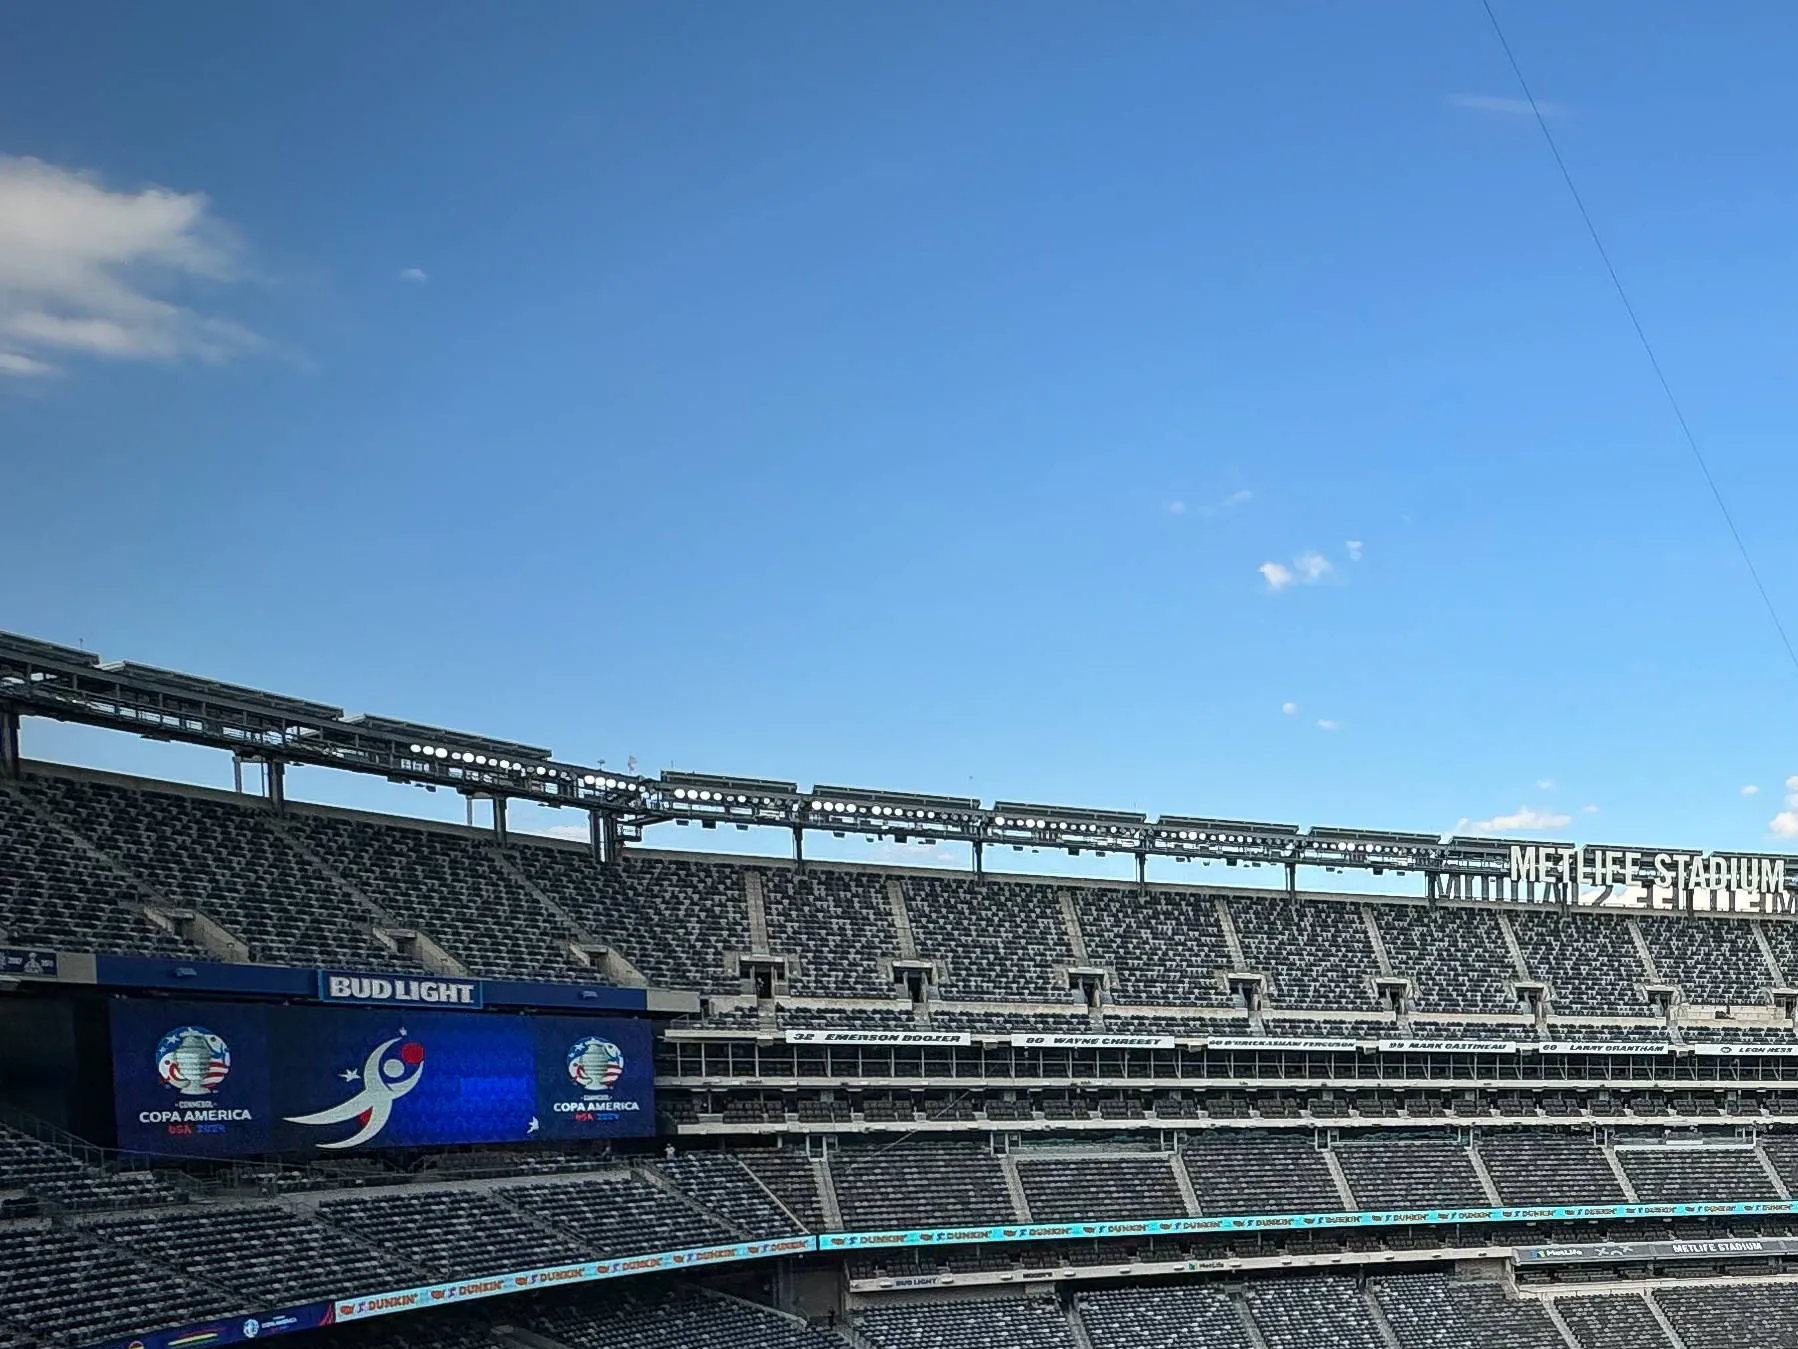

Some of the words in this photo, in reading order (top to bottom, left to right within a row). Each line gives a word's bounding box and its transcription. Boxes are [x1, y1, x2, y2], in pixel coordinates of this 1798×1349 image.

[1510, 845, 1642, 887] METLIFE
[1654, 853, 1785, 894] STADIUM
[329, 976, 392, 999] BUD
[395, 980, 475, 1003] LIGHT
[553, 1102, 586, 1112] COPA
[587, 1101, 640, 1111] AMERICA
[139, 1111, 181, 1123] COPA
[184, 1109, 252, 1122] AMERICA
[1545, 1248, 1583, 1258] MetLife
[1672, 1243, 1717, 1253] METLIFE
[1718, 1242, 1764, 1252] STADIUM
[368, 1293, 418, 1311] DUNKIN'
